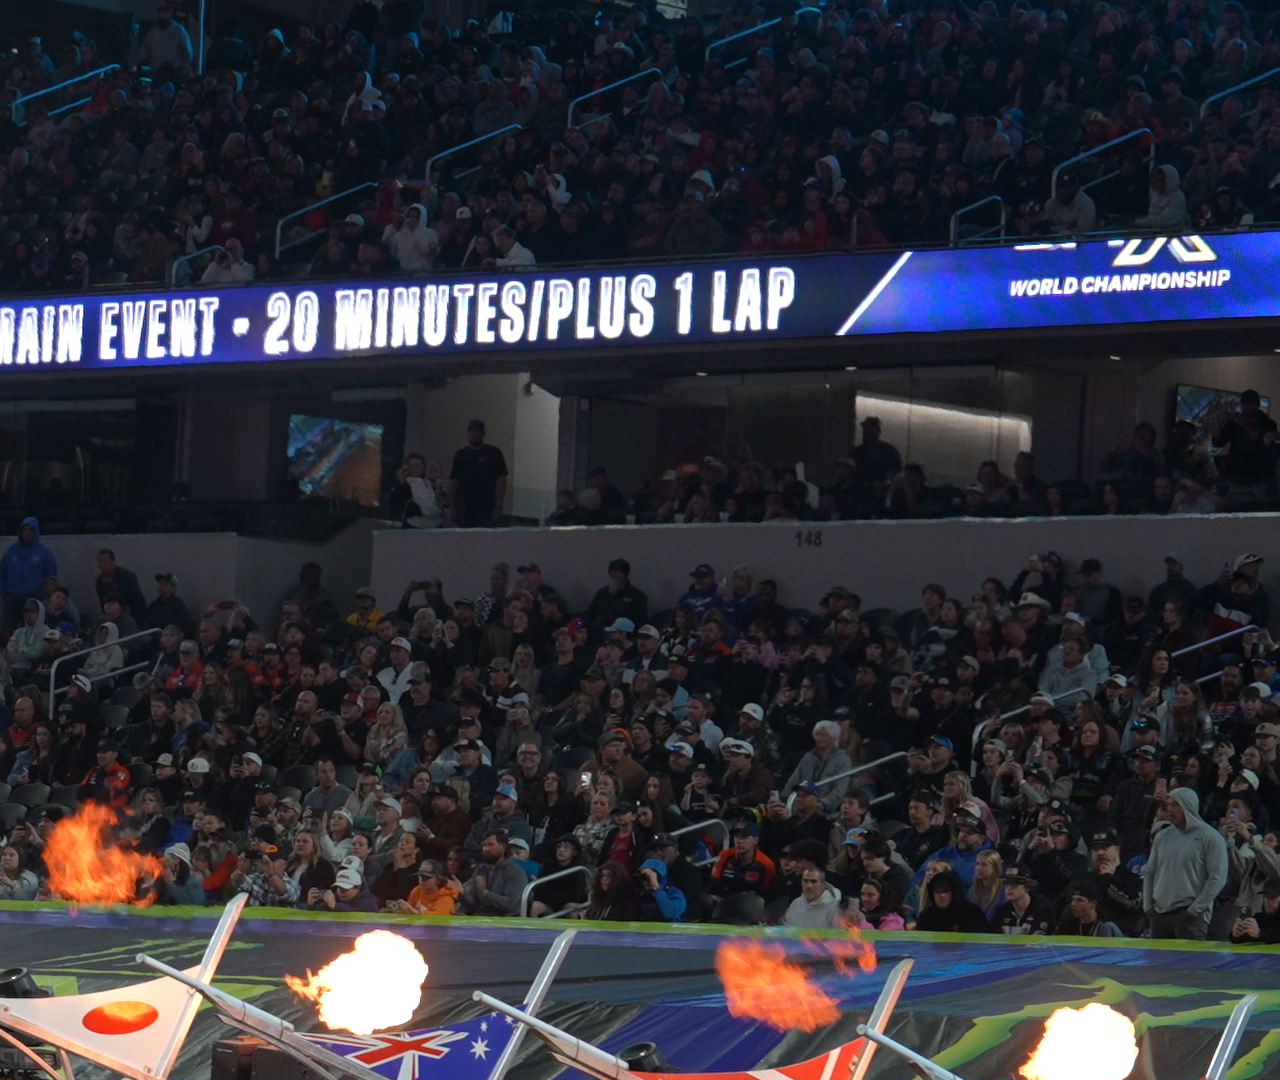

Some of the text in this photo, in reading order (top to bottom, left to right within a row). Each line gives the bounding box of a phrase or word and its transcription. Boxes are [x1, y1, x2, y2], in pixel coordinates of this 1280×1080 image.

[1009, 270, 1231, 297] WORLD CHAMPIONSHIP
[99, 297, 218, 360] EVENT
[263, 292, 319, 354] 20
[335, 274, 656, 351] MINUTES/PLUS
[673, 272, 694, 334] 1
[711, 267, 795, 333] LAP
[795, 530, 822, 547] 148
